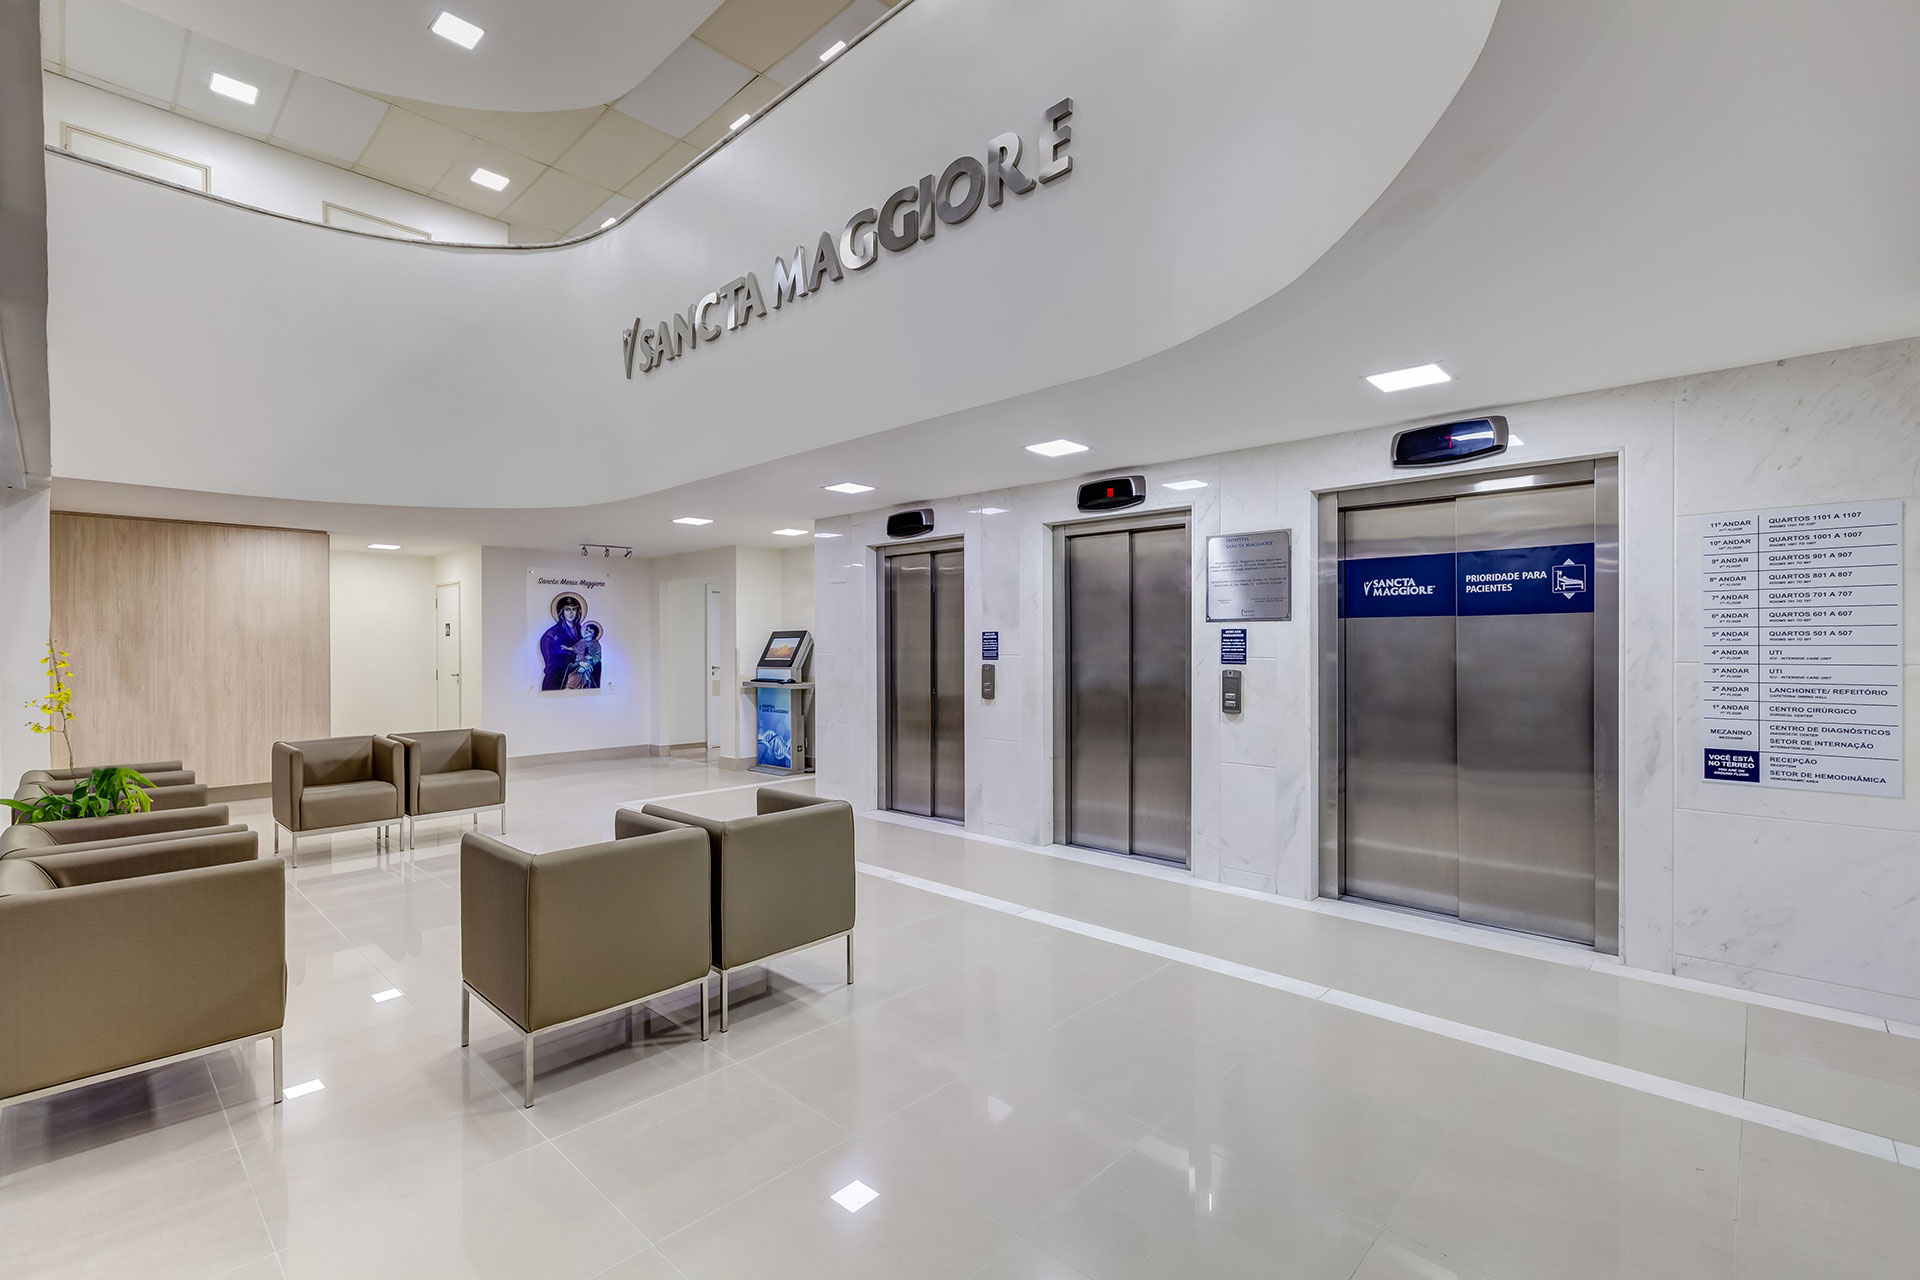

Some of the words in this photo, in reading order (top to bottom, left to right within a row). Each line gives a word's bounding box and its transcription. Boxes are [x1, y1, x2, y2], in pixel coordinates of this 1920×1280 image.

[640, 271, 767, 373] SANCTA
[773, 96, 1073, 310] MAGGIORE
[1768, 516, 1810, 524] QUARTOS
[1466, 572, 1520, 582] PRIORIDADE
[1522, 571, 1547, 580] PARA
[579, 580, 605, 589] Maggiore
[1373, 578, 1416, 588] SANCTA
[1466, 583, 1512, 593] PACIENTES
[1373, 585, 1433, 596] MAGGIORE
[1821, 727, 1891, 736] DIAGNÓSTICOS
[1814, 740, 1874, 749] INTERNAÇÃO
[1770, 757, 1817, 765] RECEPÇÃO
[1814, 773, 1887, 784] HEMODINÂMICA
